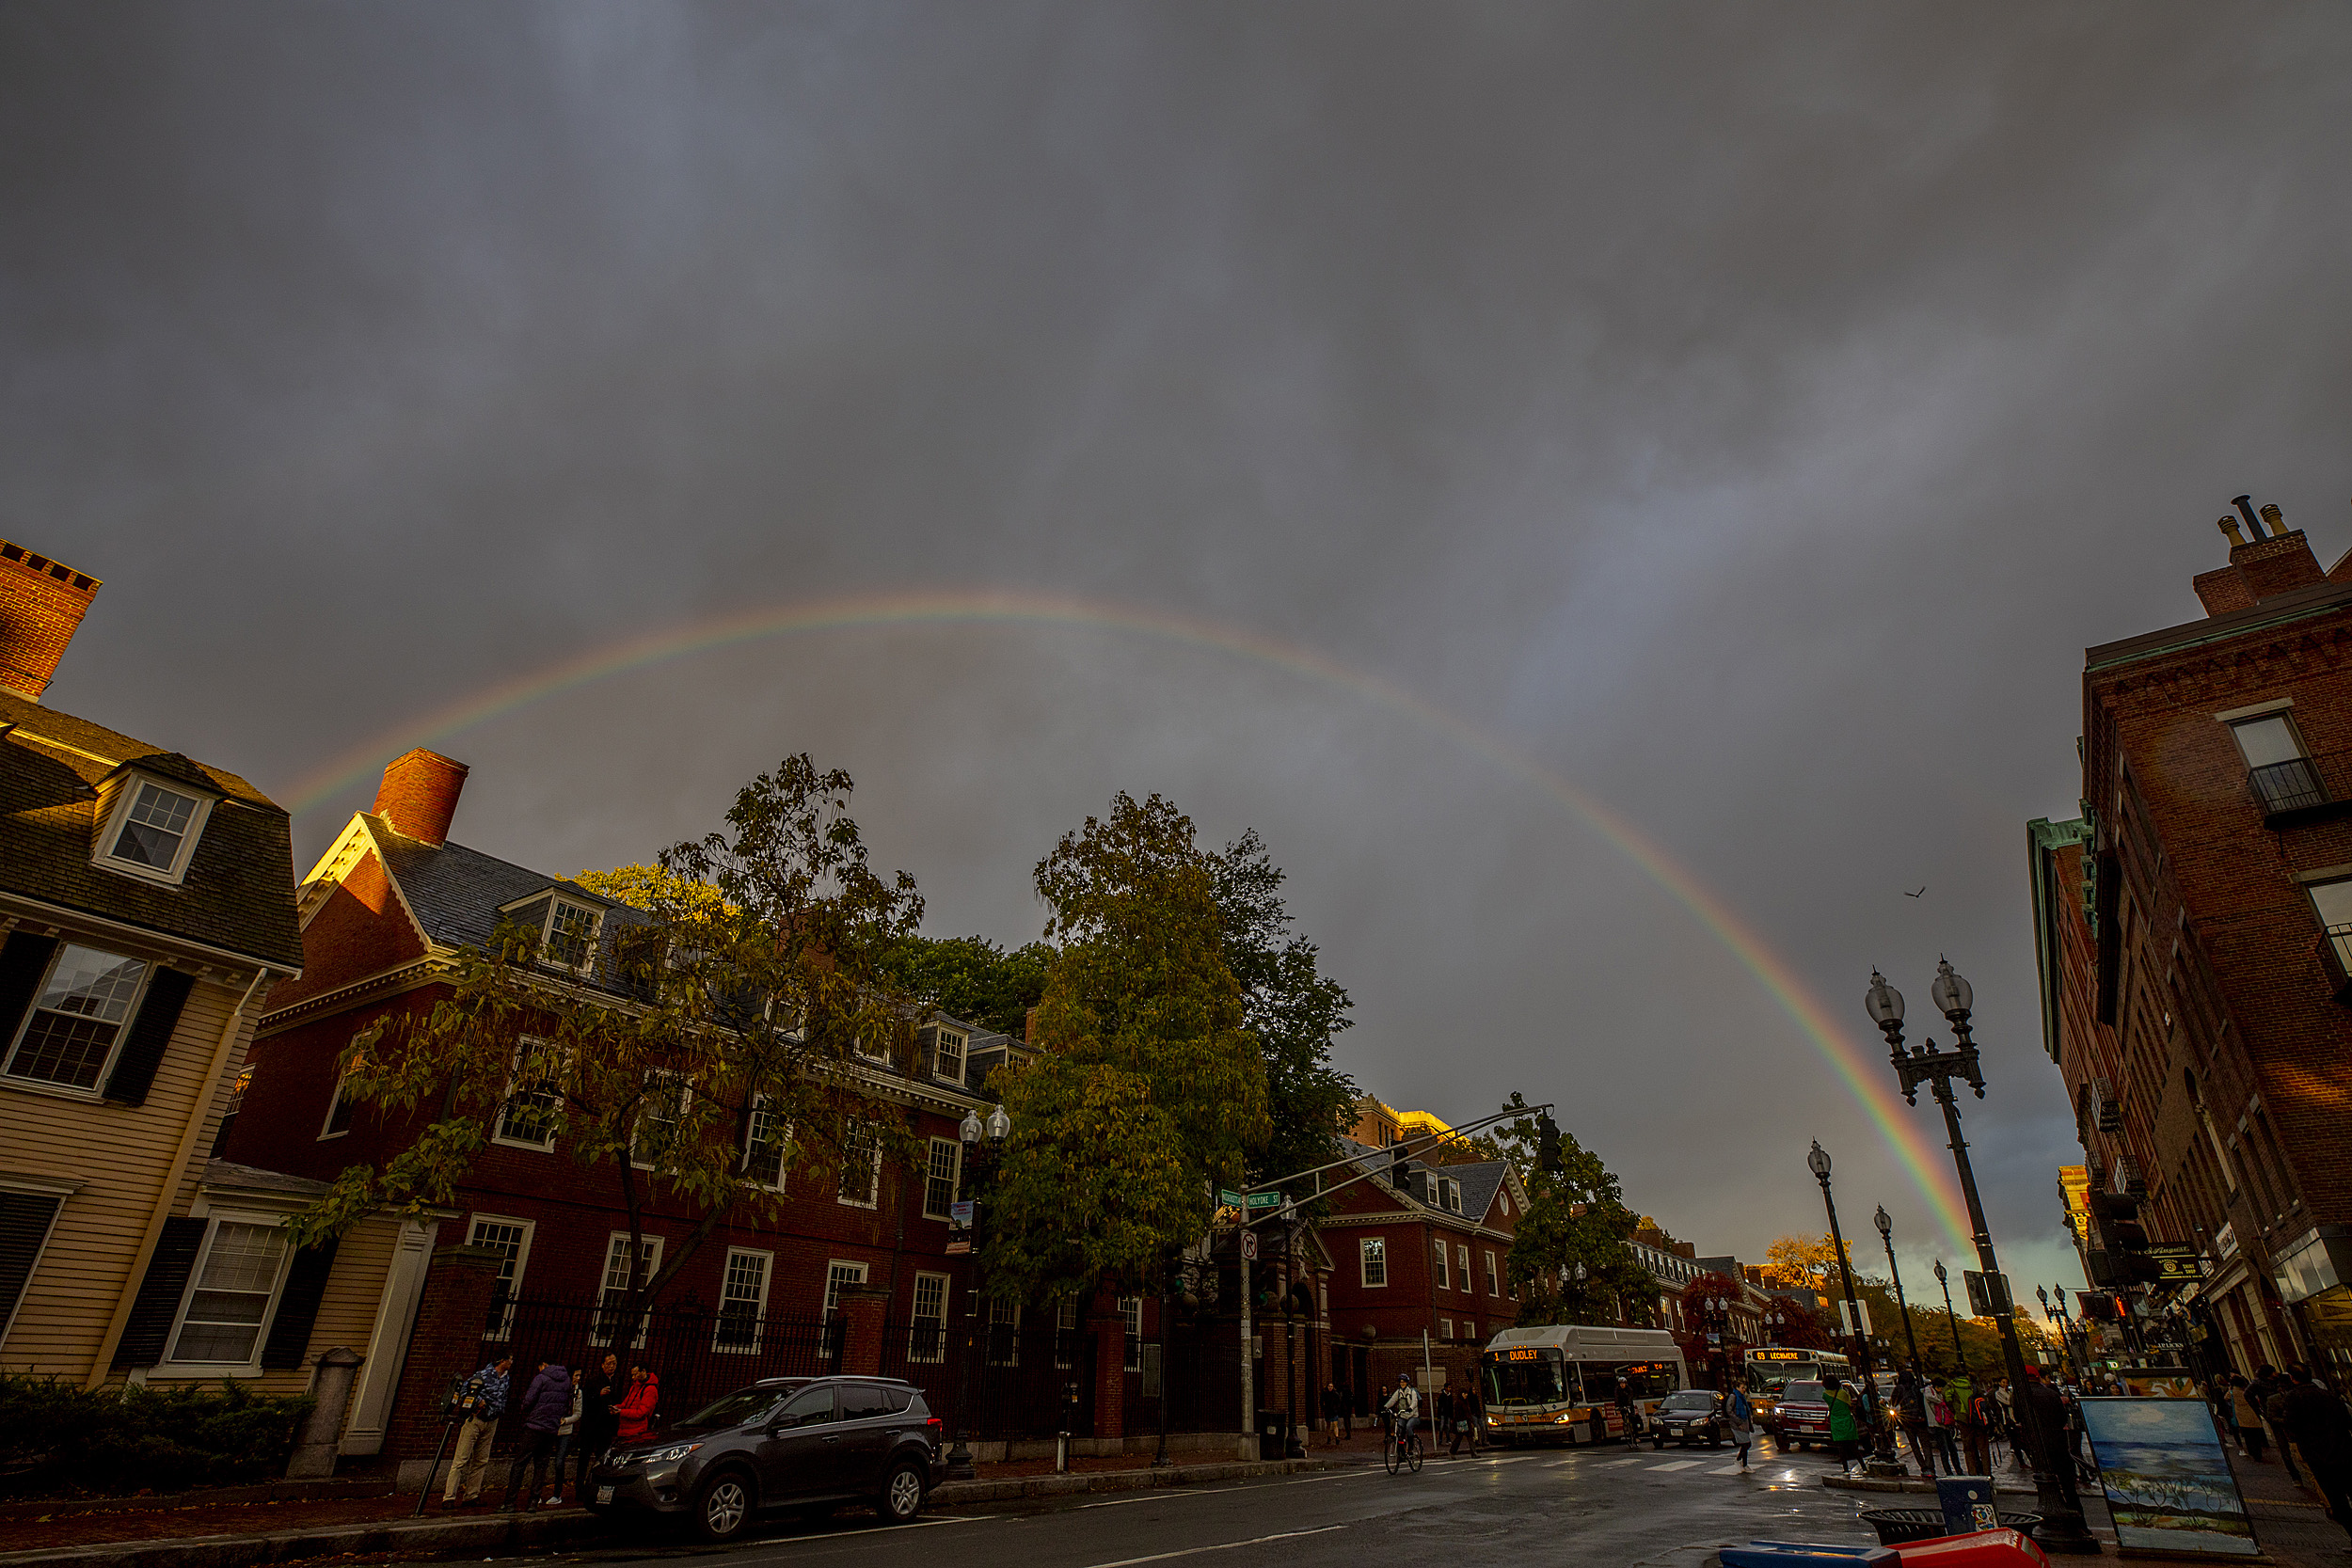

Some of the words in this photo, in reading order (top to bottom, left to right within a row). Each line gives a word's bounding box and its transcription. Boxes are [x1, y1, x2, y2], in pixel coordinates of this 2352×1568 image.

[1249, 1196, 1269, 1205] HOLYOKE
[1494, 1352, 1500, 1362] 1
[1509, 1349, 1537, 1361] DUDLEY
[1757, 1352, 1765, 1360] 69
